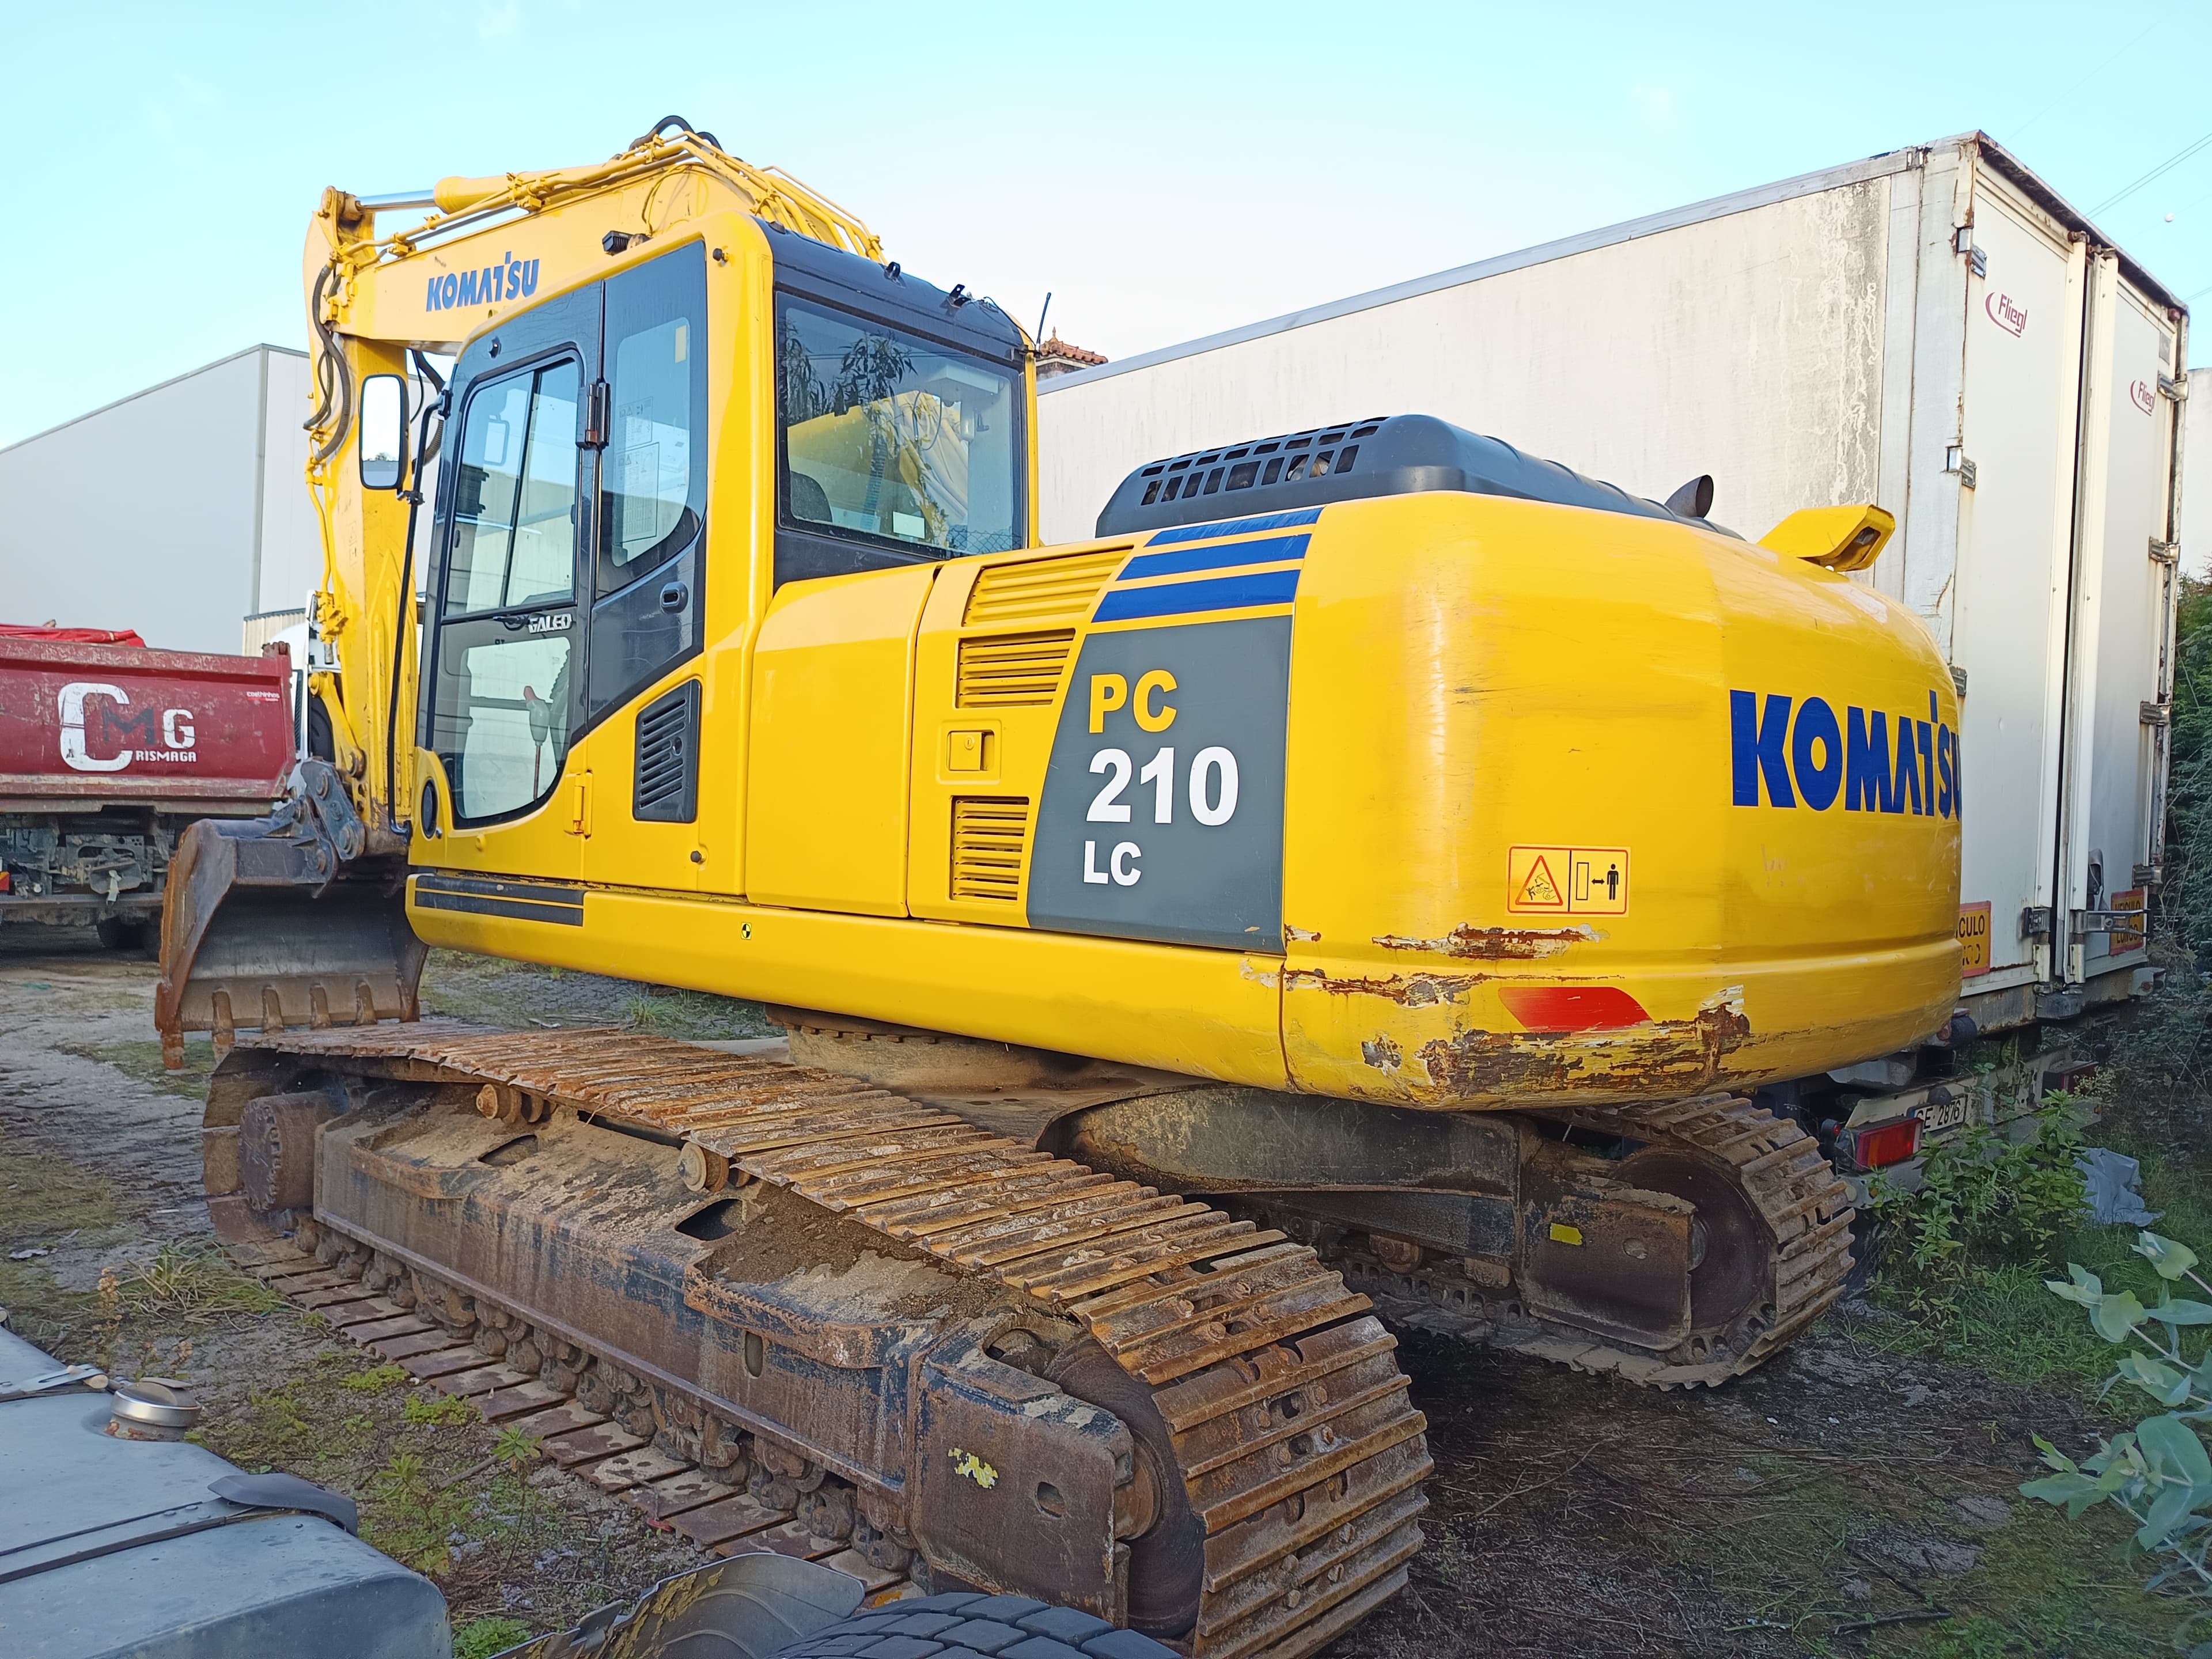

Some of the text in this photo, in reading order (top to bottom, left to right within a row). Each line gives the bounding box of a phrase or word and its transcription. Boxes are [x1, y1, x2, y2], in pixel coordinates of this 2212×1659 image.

[426, 251, 540, 312] KOMATSU
[1998, 293, 2028, 334] Fliegl
[2138, 380, 2156, 413] Fliegl
[528, 613, 573, 634] GALEO
[1089, 669, 1178, 733] PC
[1729, 689, 1962, 821] KOMATSU
[1086, 746, 1240, 826] 210
[1083, 840, 1142, 887] LC
